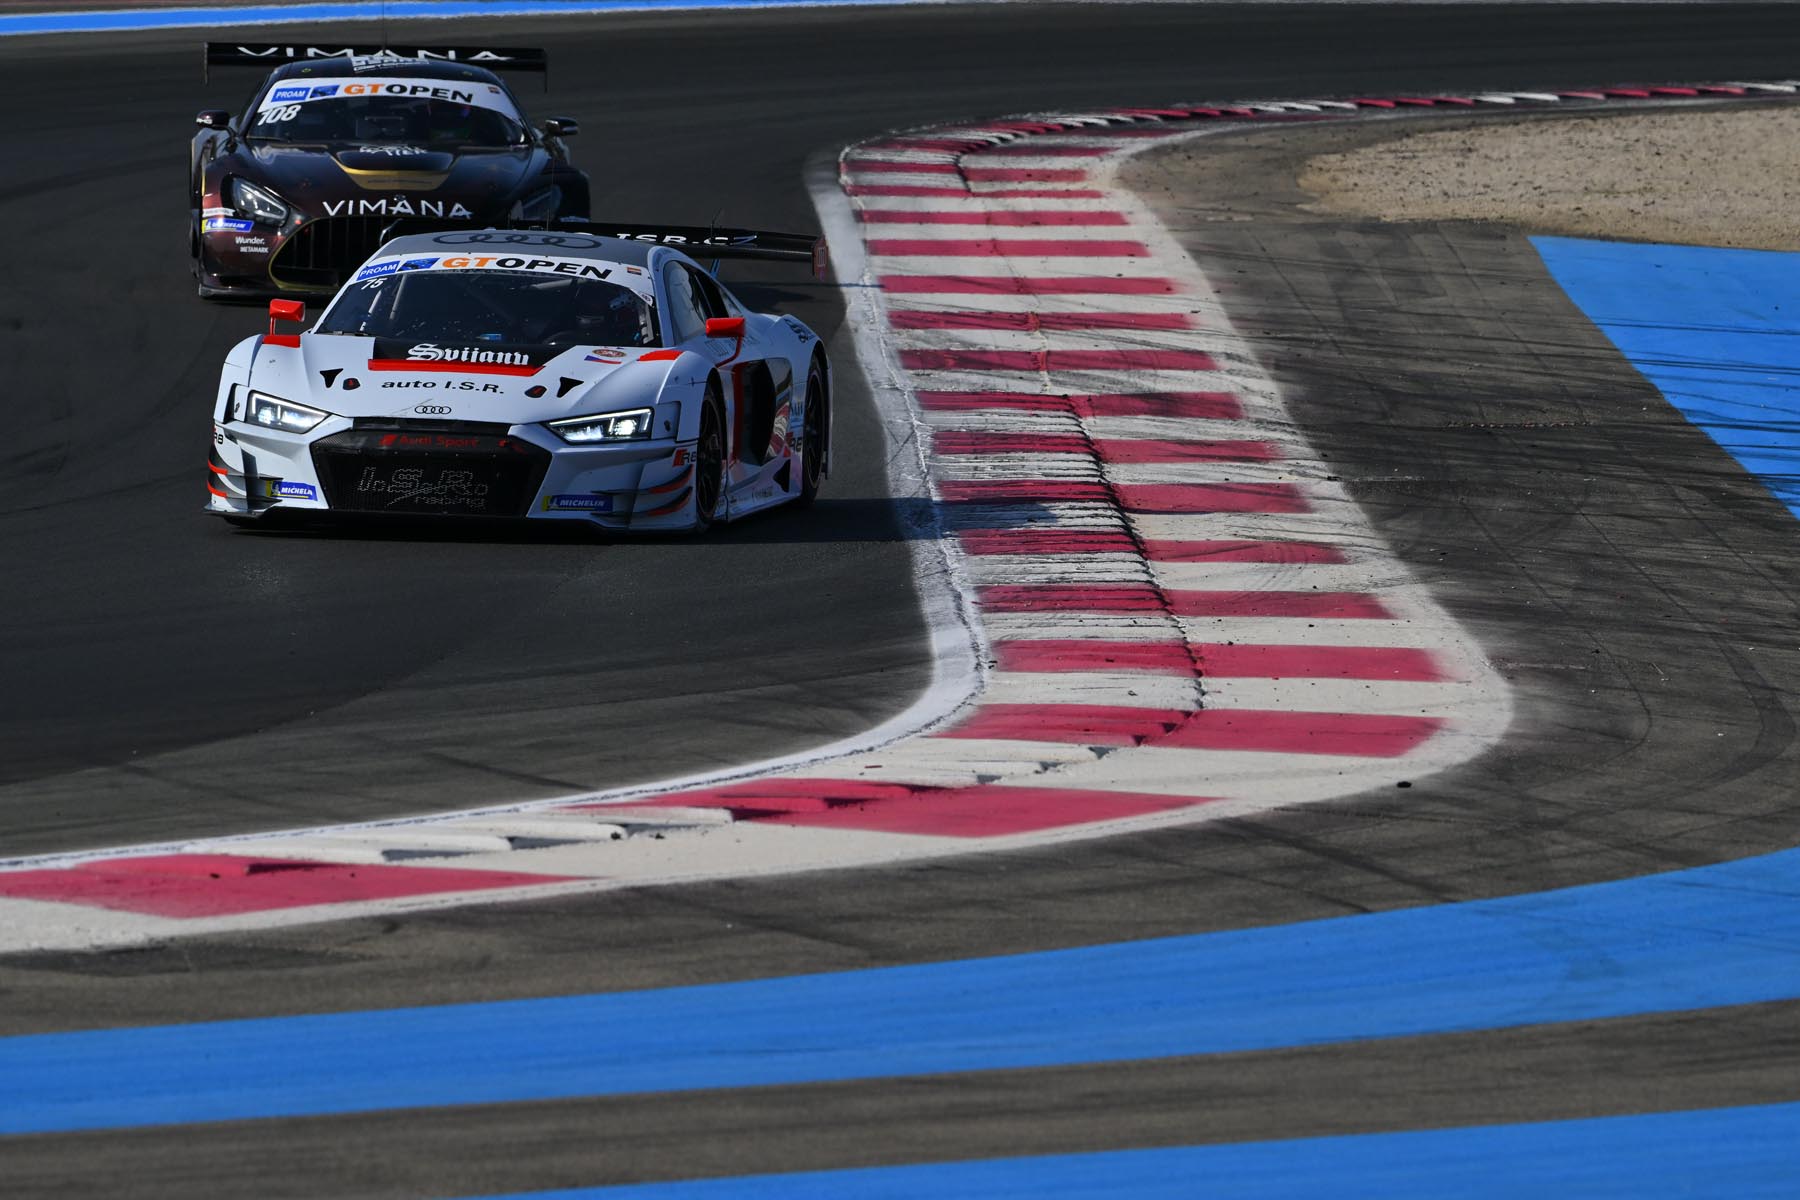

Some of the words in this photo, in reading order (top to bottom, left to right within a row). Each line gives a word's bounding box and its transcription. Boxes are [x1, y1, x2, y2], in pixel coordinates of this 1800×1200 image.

[237, 46, 515, 61] VIMANA
[275, 89, 306, 99] PROAM
[257, 104, 302, 126] 108
[322, 199, 473, 219] VIMANA
[360, 263, 398, 277] PROAM
[360, 277, 388, 290] 75
[381, 379, 437, 389] auto
[444, 380, 504, 394] I.S.R.
[400, 434, 433, 447] Audi
[436, 434, 479, 449] Sport
[560, 499, 605, 508] MICHELIN
